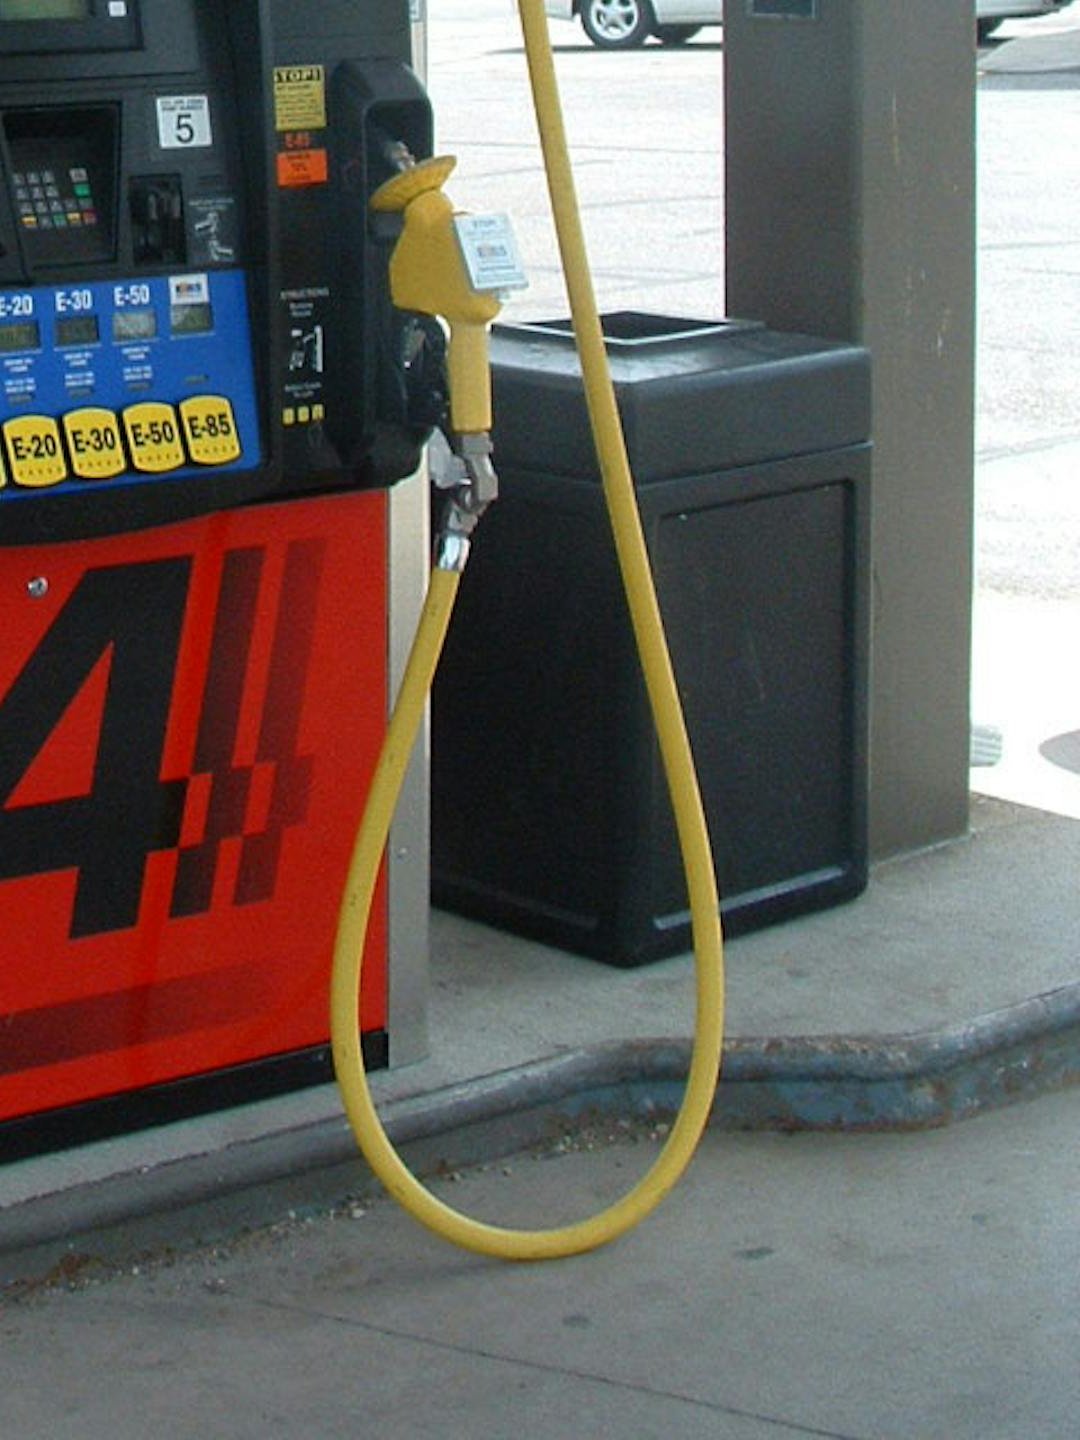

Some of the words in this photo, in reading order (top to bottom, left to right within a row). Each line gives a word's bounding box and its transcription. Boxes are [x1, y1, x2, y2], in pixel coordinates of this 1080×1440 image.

[177, 114, 195, 144] 5
[55, 289, 93, 312] E-30
[114, 284, 150, 306] E-50
[12, 434, 57, 460] E-20
[71, 427, 116, 453] E-30
[131, 420, 175, 446] E-50
[188, 412, 231, 439] E-85
